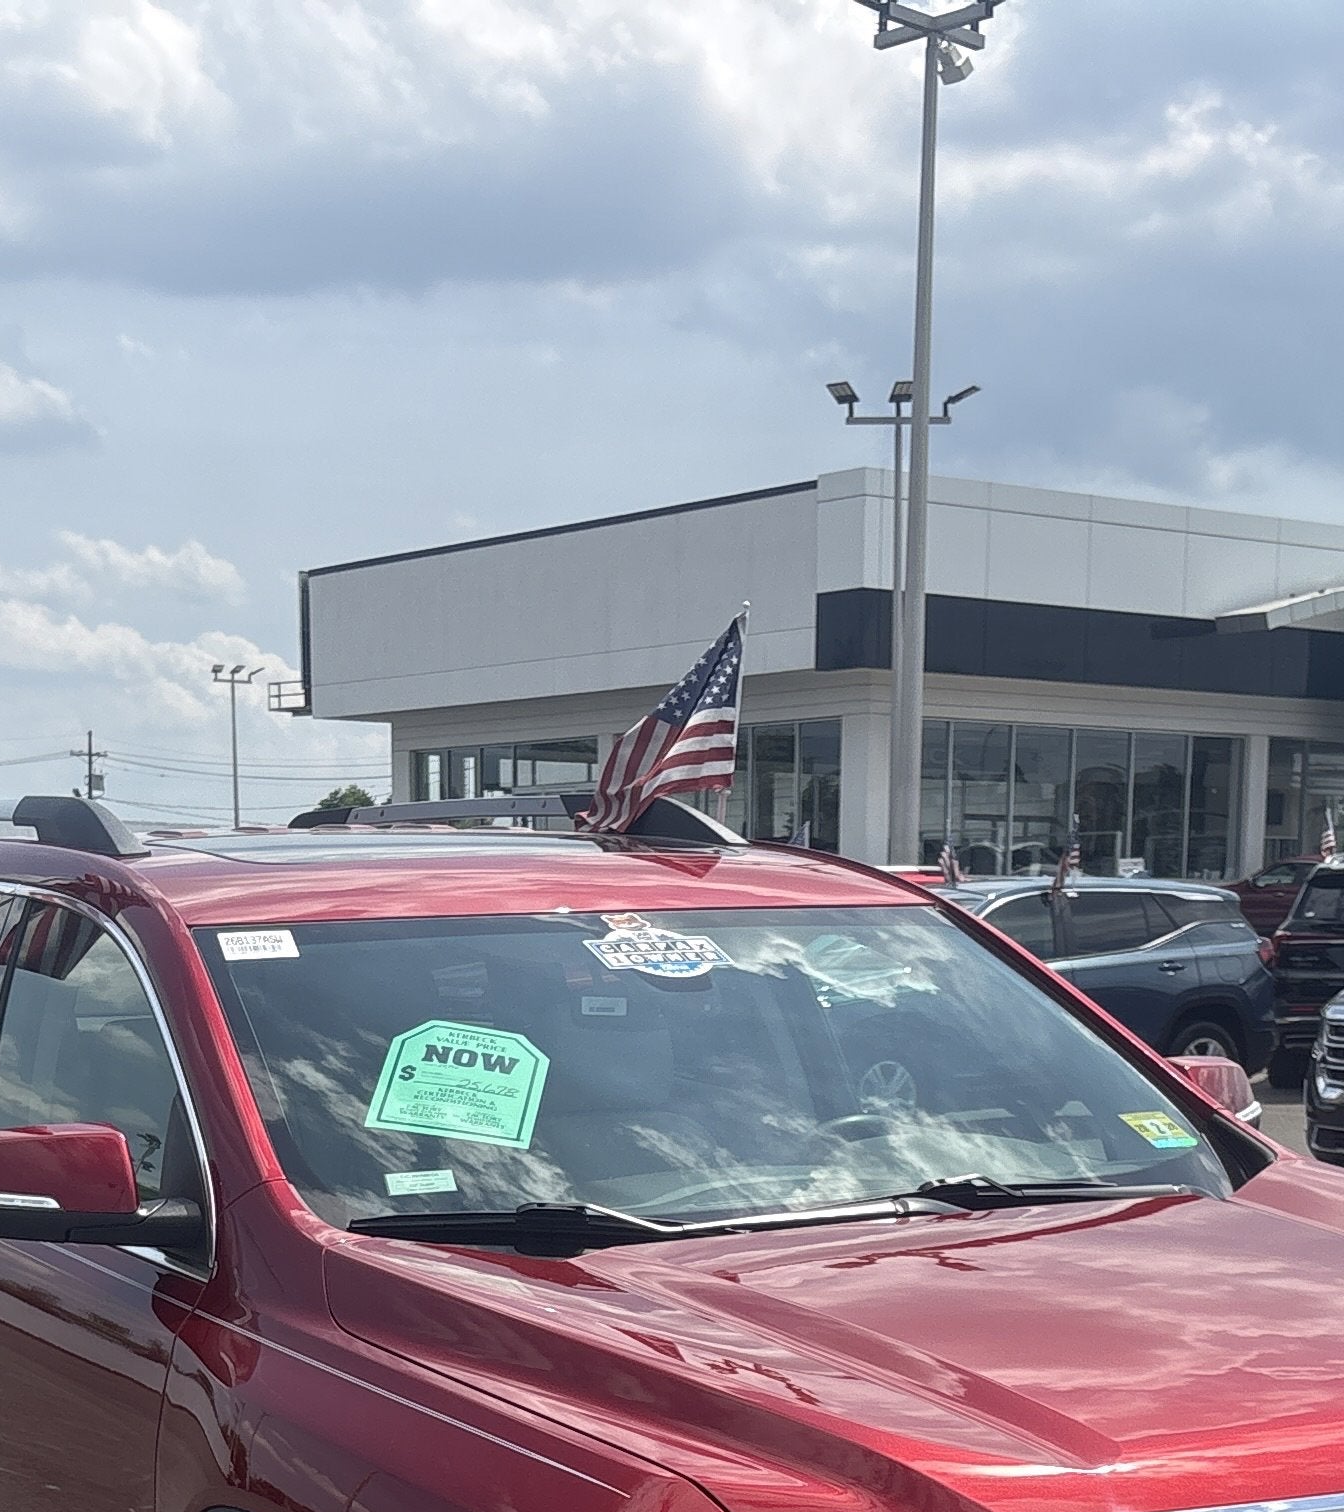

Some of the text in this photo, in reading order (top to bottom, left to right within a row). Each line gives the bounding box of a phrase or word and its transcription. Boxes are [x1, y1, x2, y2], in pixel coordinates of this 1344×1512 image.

[599, 940, 710, 954] CARFAX
[436, 1036, 507, 1053] VALUE PRICE
[448, 1031, 497, 1045] KERBECK
[421, 1044, 520, 1075] NOW
[398, 1064, 417, 1082] $
